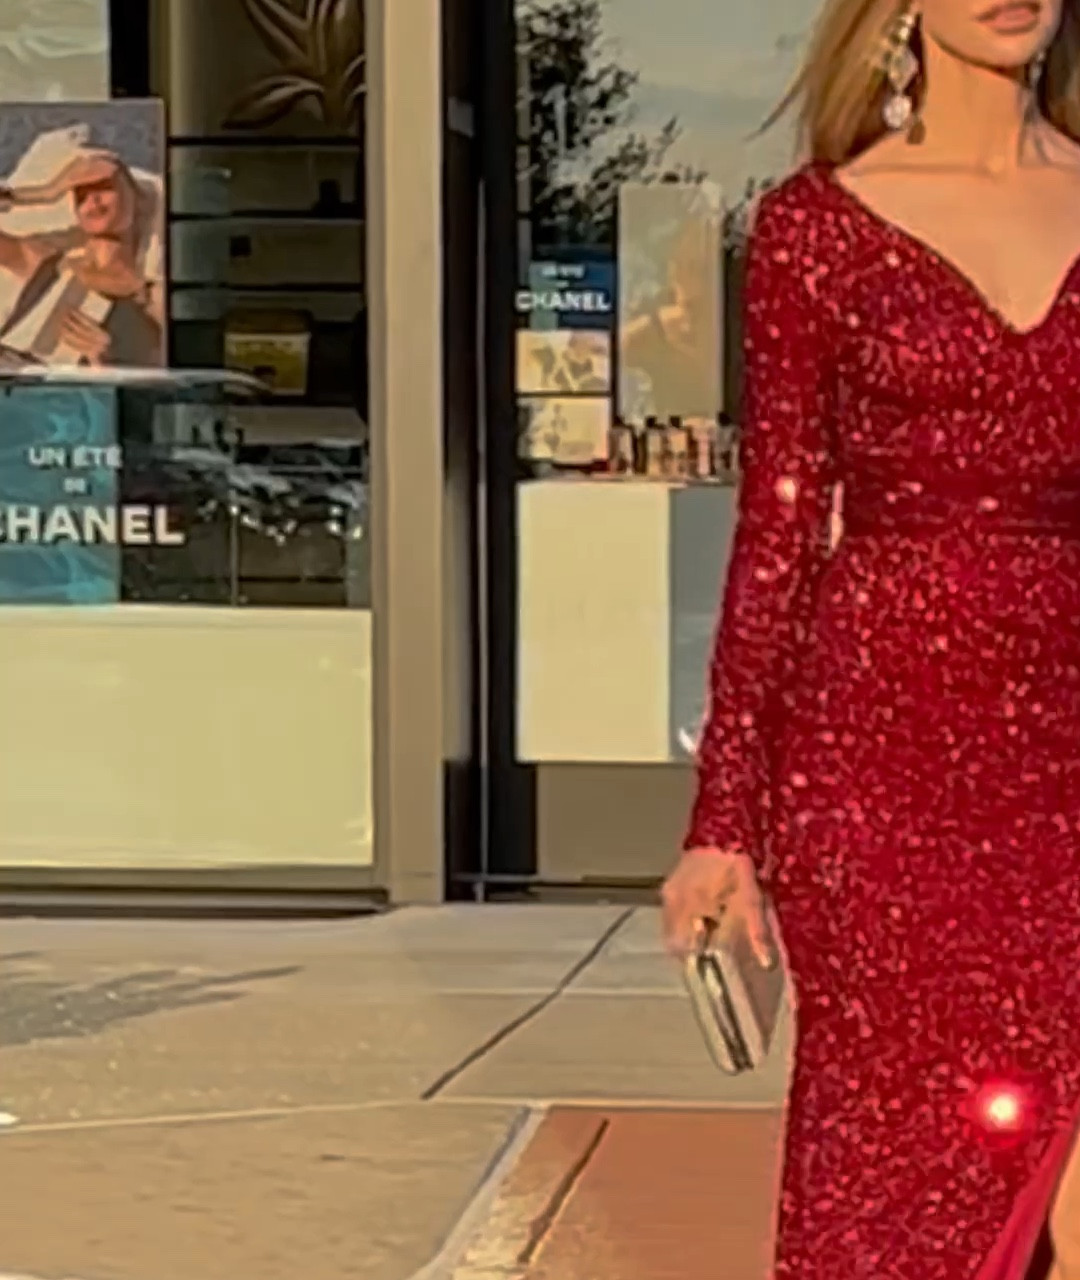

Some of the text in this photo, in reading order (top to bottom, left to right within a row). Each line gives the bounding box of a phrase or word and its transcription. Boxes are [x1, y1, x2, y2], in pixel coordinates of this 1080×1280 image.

[514, 290, 612, 312] CHANEL
[28, 446, 66, 468] UN
[0, 504, 186, 546] HANEL
